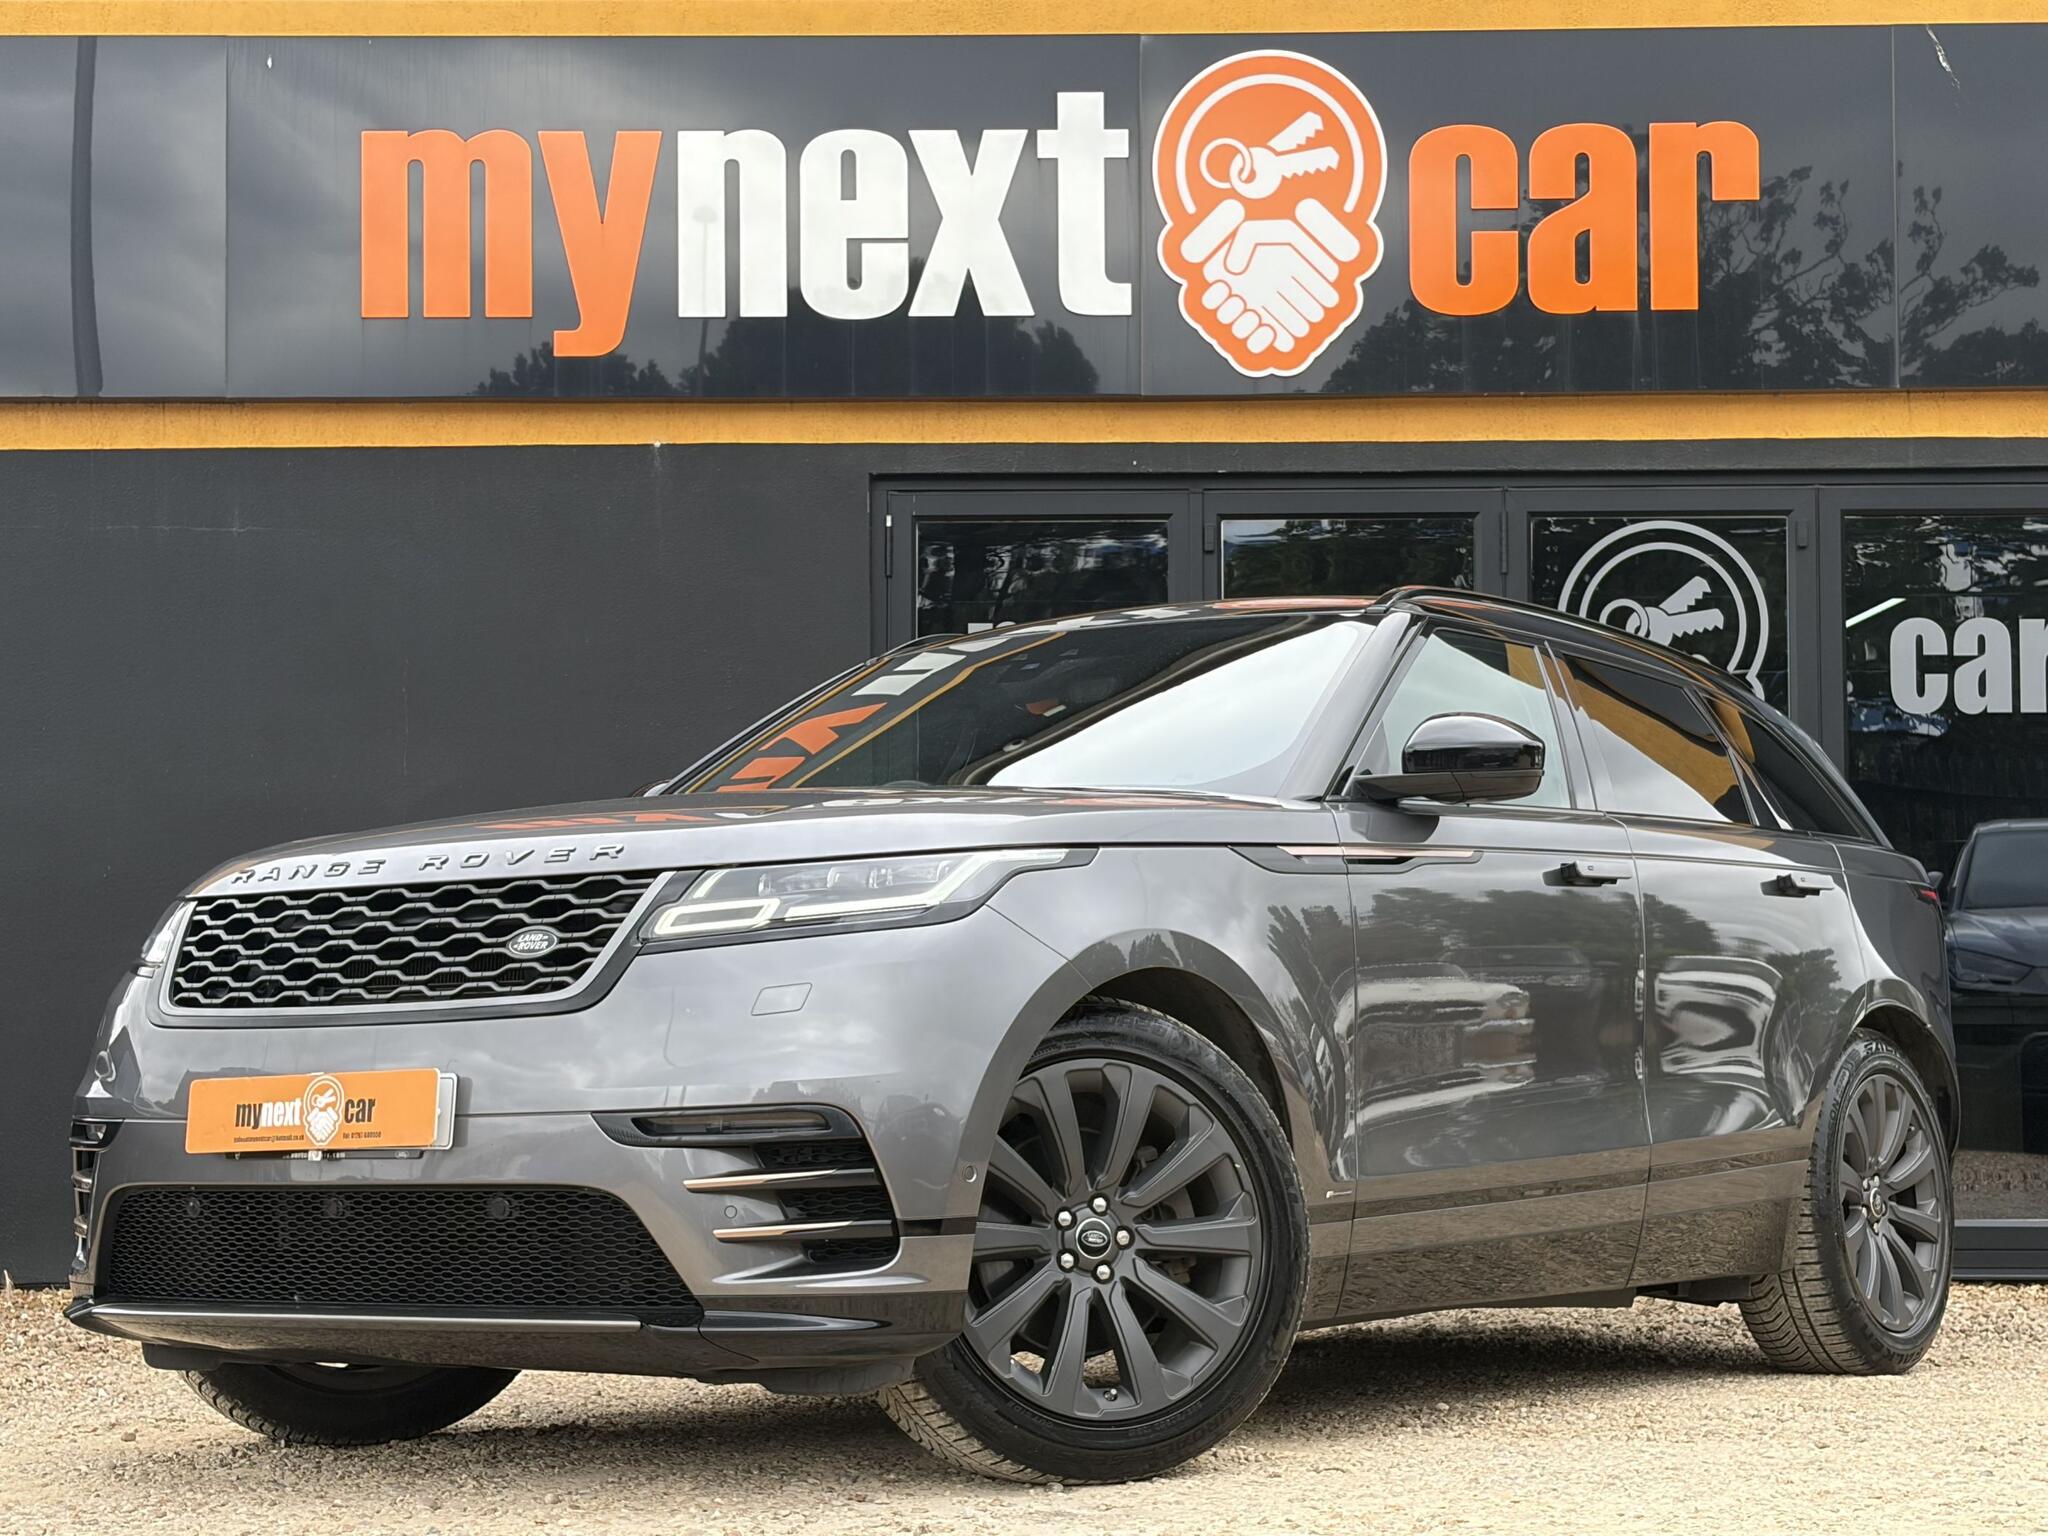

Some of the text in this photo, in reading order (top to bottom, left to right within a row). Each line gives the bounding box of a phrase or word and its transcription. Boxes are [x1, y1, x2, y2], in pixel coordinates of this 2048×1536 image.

[1408, 120, 1761, 316] car
[230, 842, 626, 885] RANGE ROVER
[517, 933, 544, 943] LAND
[517, 941, 549, 951] ROVER
[344, 1098, 377, 1124] car
